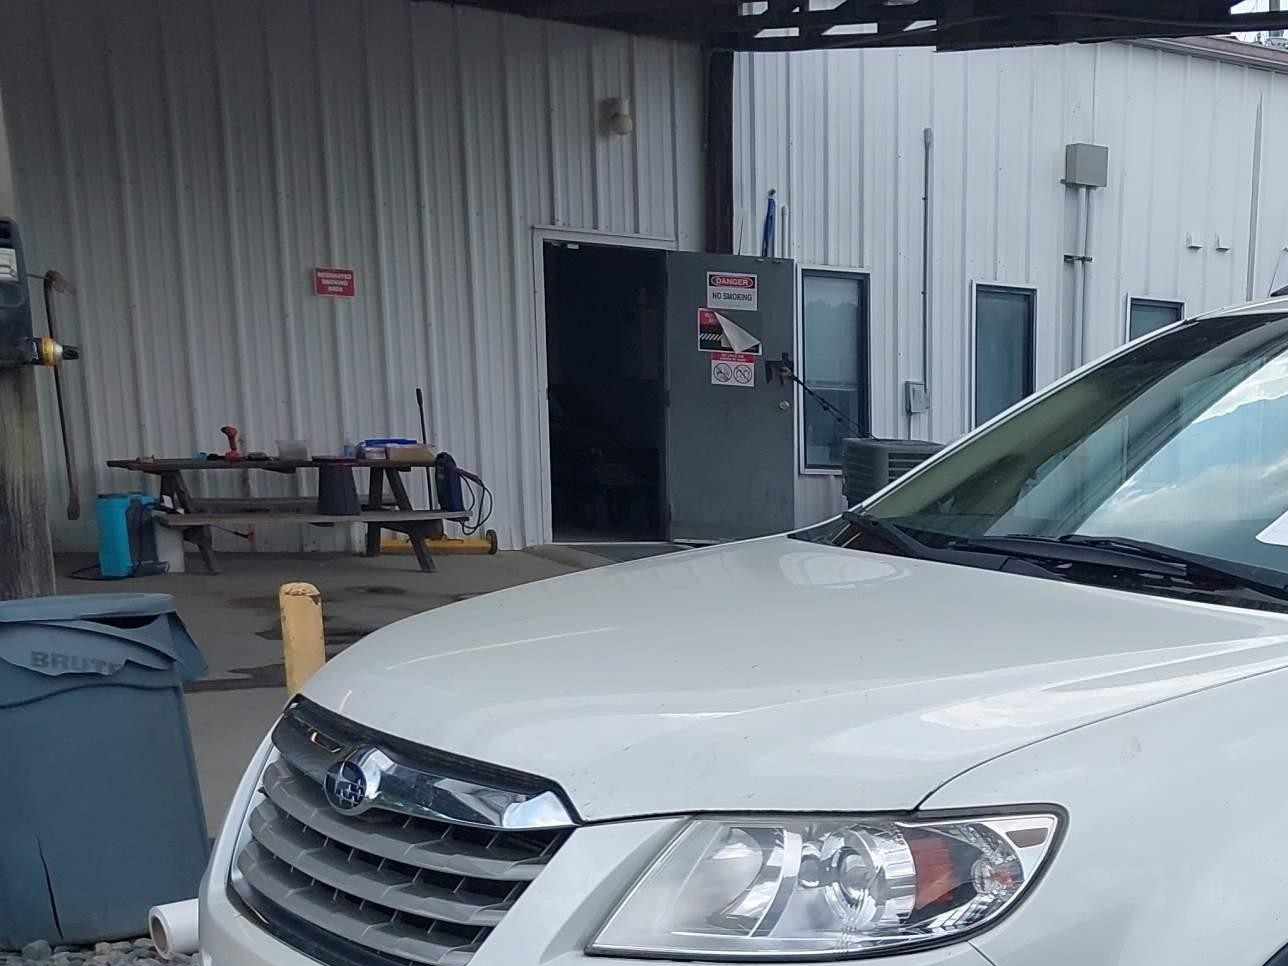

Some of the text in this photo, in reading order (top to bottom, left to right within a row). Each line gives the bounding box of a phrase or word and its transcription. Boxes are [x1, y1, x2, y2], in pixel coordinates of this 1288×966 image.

[715, 277, 749, 286] DANGER
[712, 290, 753, 301] NO SMOKING
